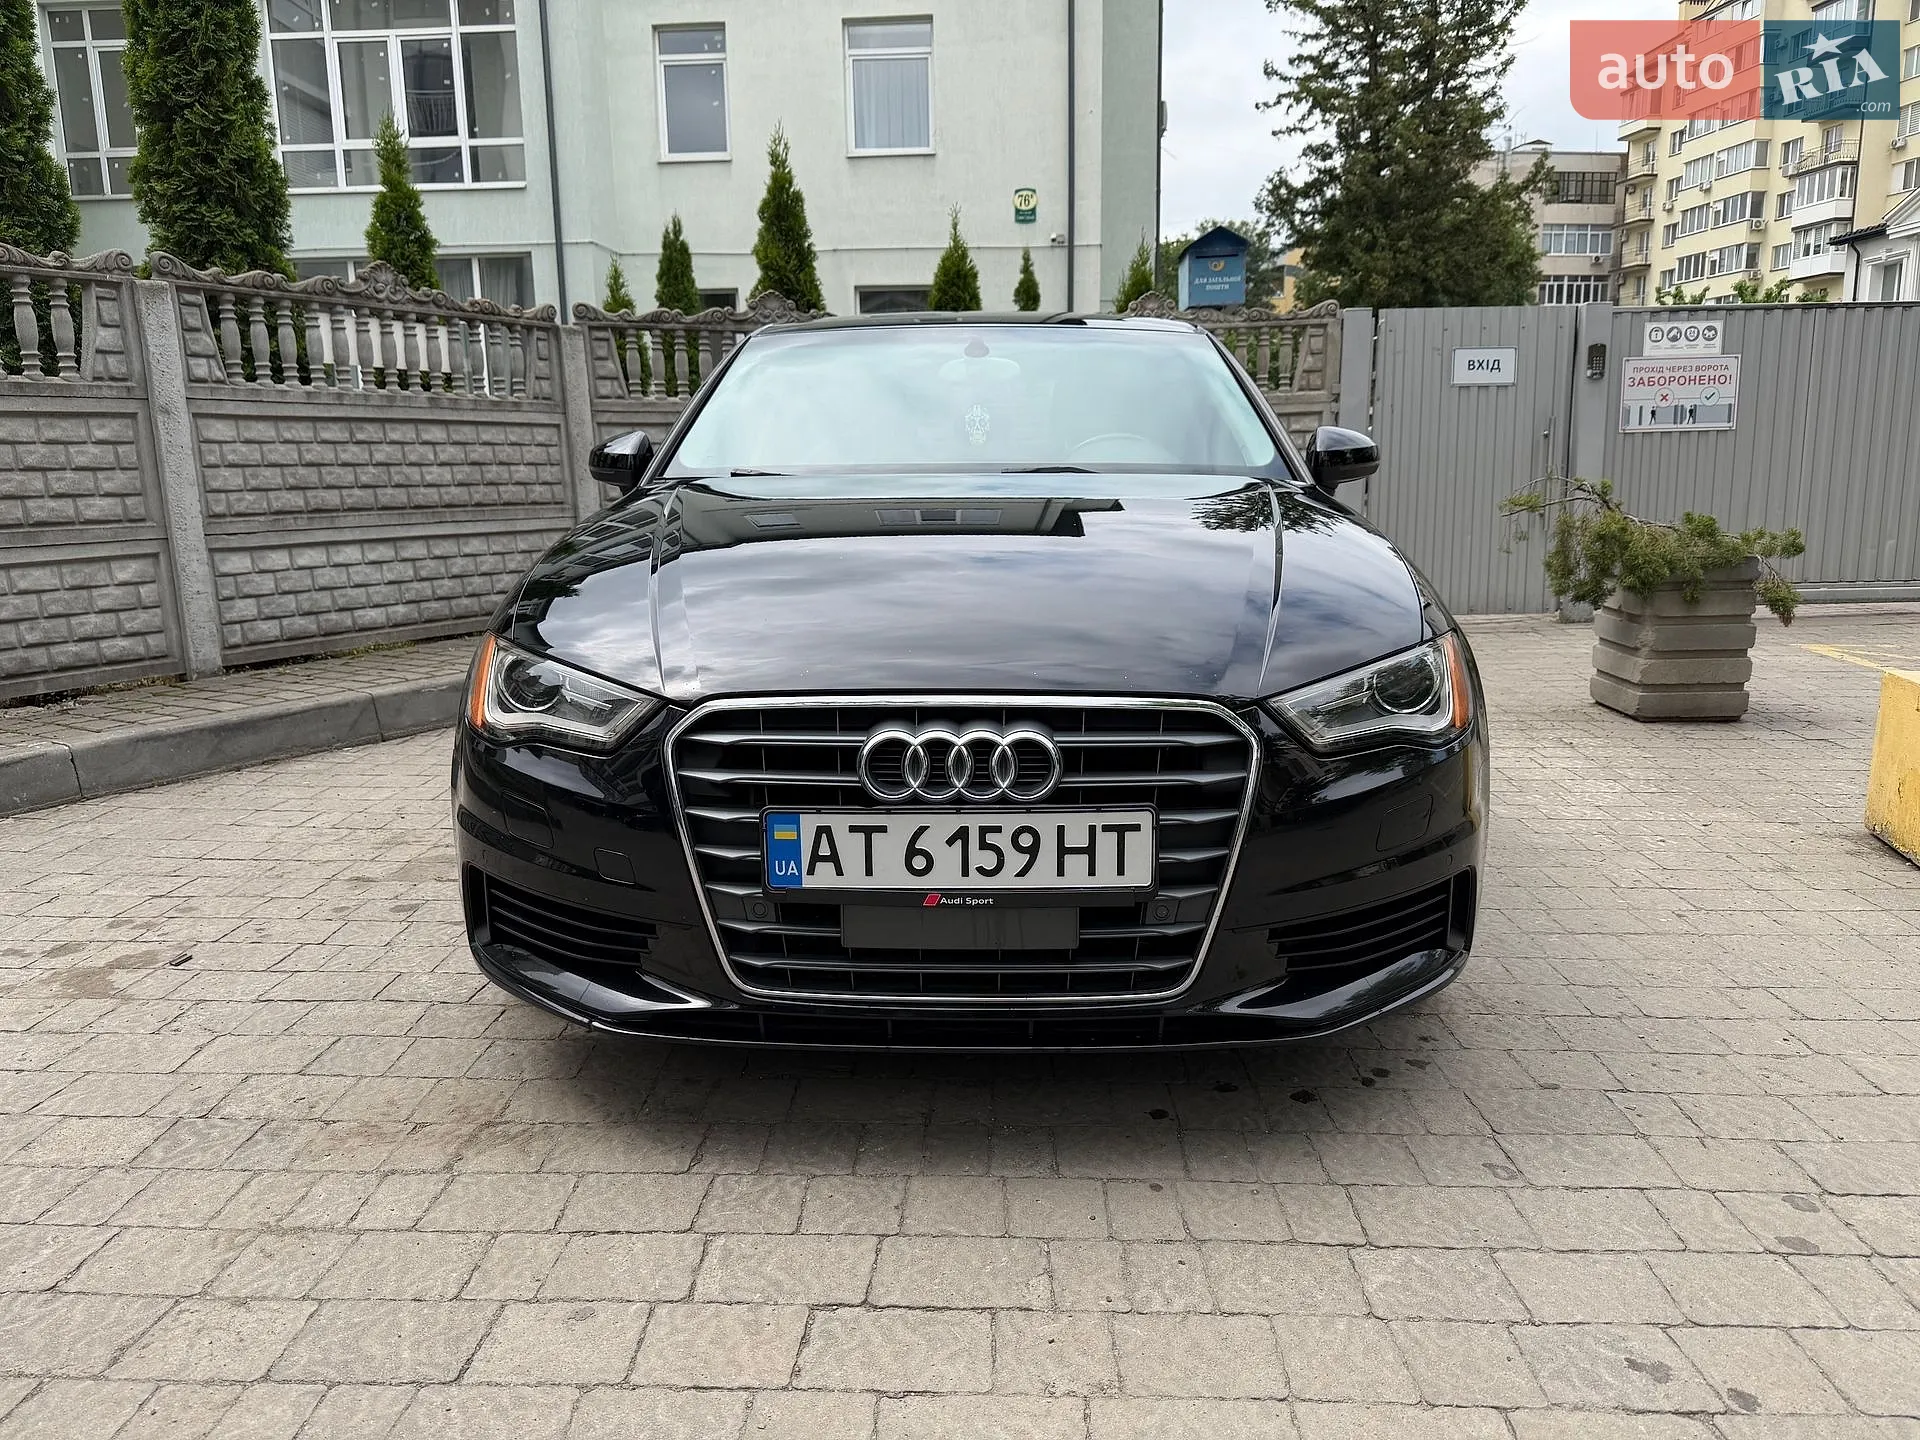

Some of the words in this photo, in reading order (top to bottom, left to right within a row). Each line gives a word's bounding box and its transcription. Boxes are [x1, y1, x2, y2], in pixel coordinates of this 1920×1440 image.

[1467, 359, 1502, 373] ВХІД
[1632, 365, 1664, 374] ПРОХІД
[1666, 365, 1693, 373] ЧЕРЕЗ
[1695, 364, 1730, 372] ВОРОТА
[1627, 374, 1733, 388] ЗАБОРОНЕНО!
[806, 824, 888, 877] AT
[903, 825, 1041, 878] 6159
[1056, 823, 1142, 877] HT
[775, 860, 799, 876] UA
[940, 897, 963, 905] Audi
[965, 897, 994, 906] Sport
